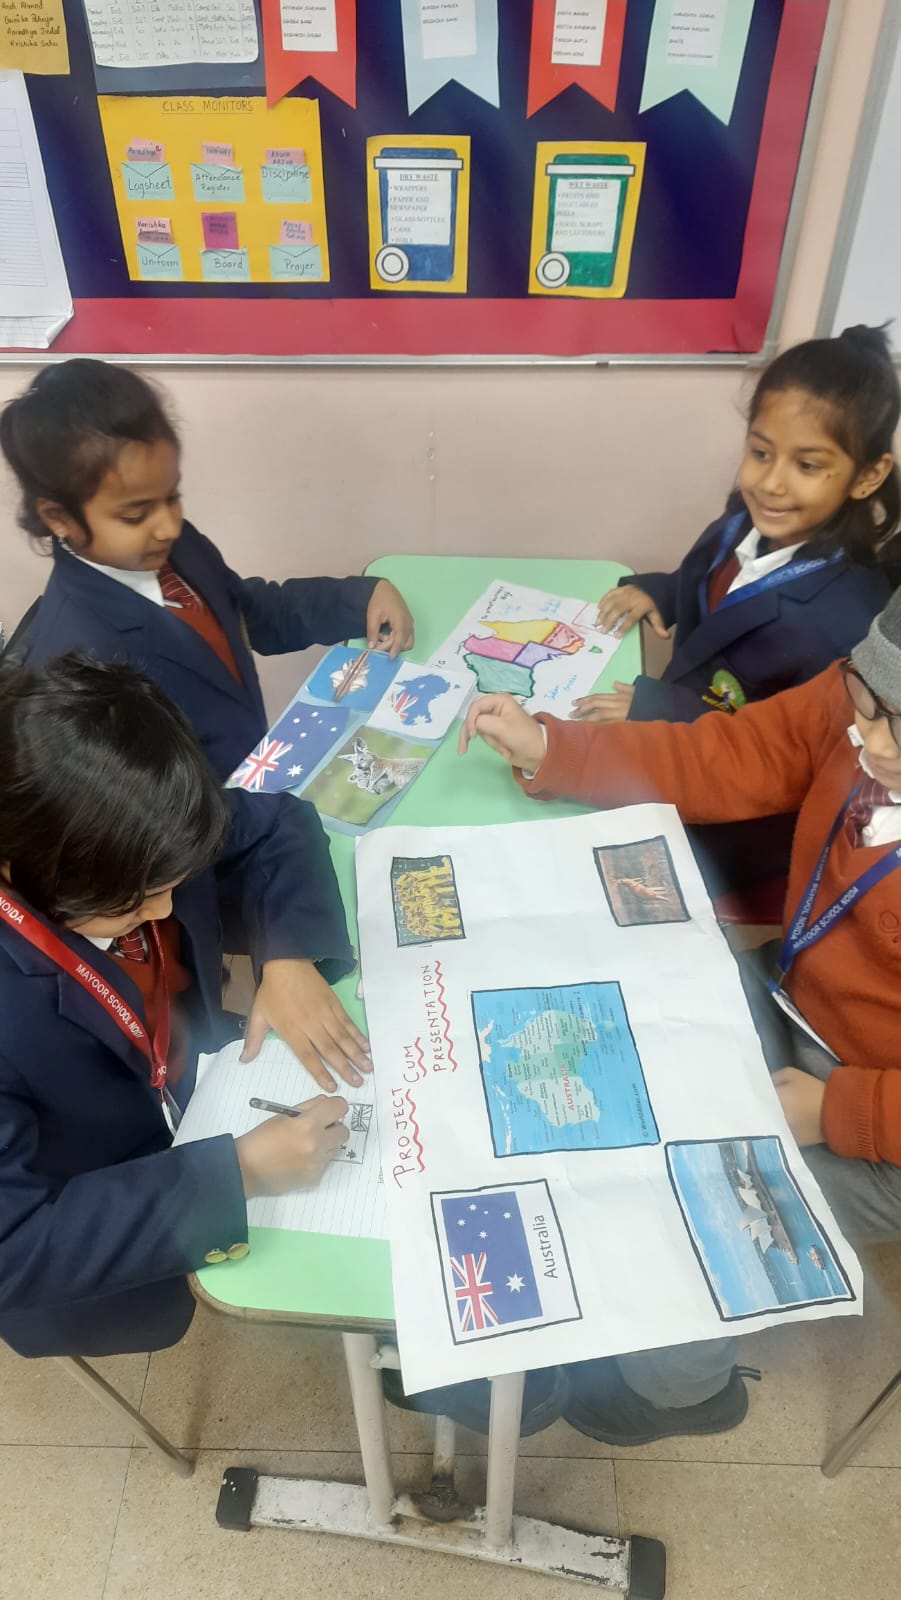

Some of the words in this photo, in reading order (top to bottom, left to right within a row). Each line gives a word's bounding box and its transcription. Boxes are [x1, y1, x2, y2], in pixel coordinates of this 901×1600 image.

[162, 100, 194, 112] CLASS
[203, 100, 254, 112] MONITORS
[128, 175, 172, 199] Logsheet
[195, 173, 241, 182] Attendance
[261, 168, 310, 183] Discipline
[141, 256, 179, 267] Uniform
[214, 256, 243, 269] Board
[284, 259, 315, 276] Prayer
[803, 883, 819, 915] SCHOOL
[790, 915, 807, 941] NOIDA
[793, 925, 822, 950] MAYOOR
[819, 904, 843, 928] SCHOOL
[75, 963, 110, 998] MAYOOR
[107, 994, 131, 1026] SCHOOL
[421, 965, 448, 1073] PRESENTATION
[403, 1045, 421, 1083] CUM
[560, 1063, 575, 1111] AUSTRALIA
[391, 1087, 416, 1188] PROJECT
[532, 1214, 559, 1279] Australia
